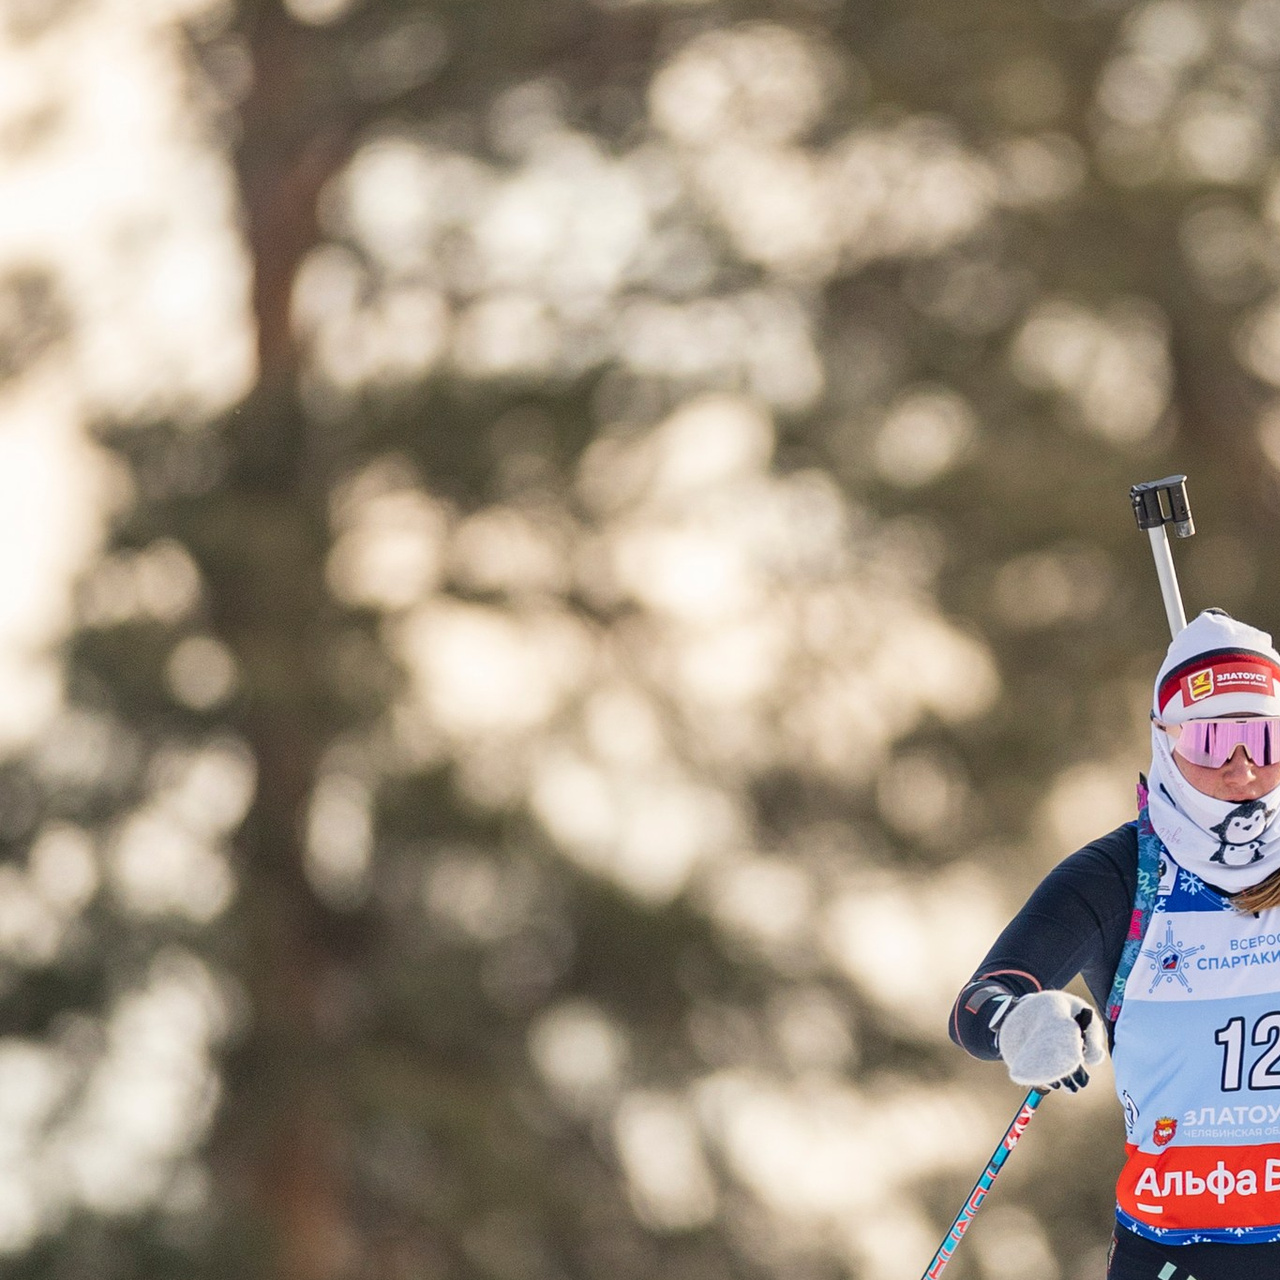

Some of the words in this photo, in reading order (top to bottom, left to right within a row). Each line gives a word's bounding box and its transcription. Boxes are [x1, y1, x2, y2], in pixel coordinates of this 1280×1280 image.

[1216, 672, 1267, 682] ЗЛАТОУСТ
[1183, 1127, 1262, 1138] ЧЕЛЯБИНСКАЯ
[1134, 1161, 1257, 1204] Альфа
